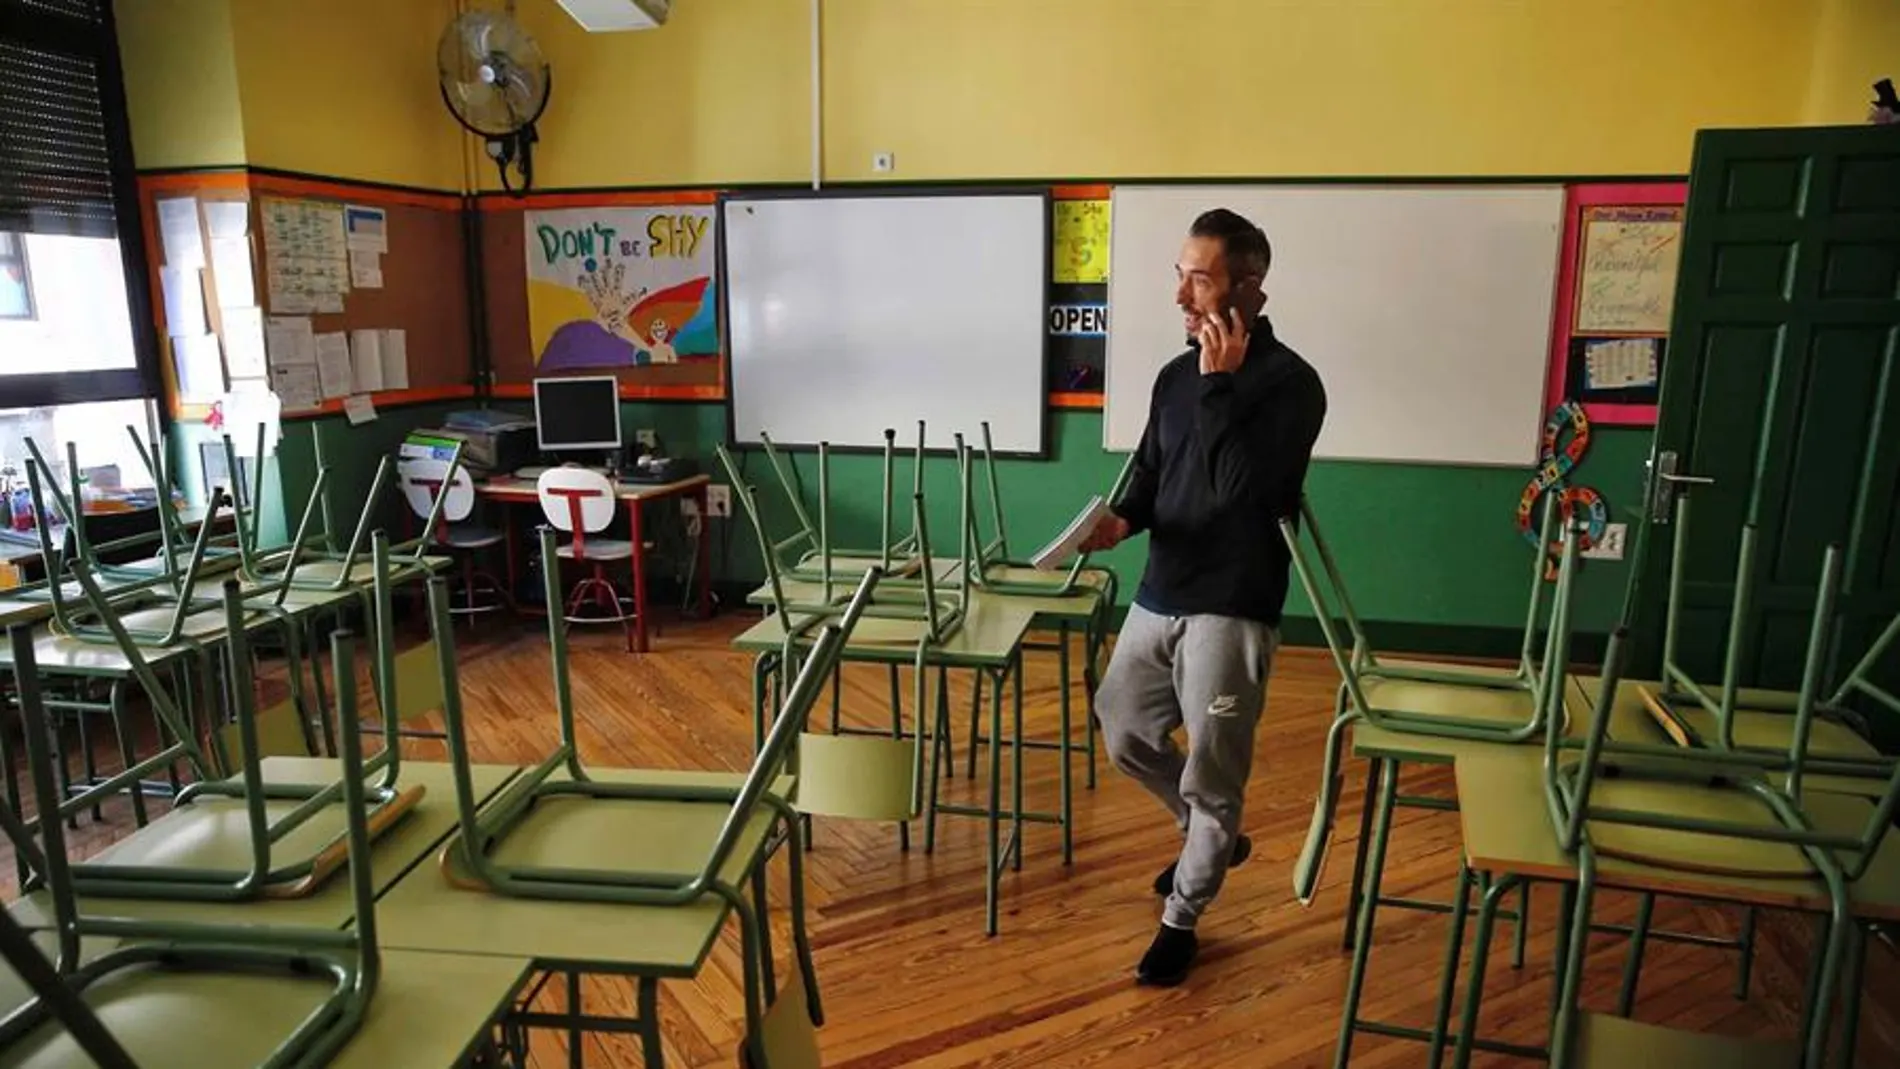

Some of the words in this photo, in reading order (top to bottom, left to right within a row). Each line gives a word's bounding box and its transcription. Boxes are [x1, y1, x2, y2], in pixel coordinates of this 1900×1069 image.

[537, 223, 616, 263] DON'T
[619, 240, 641, 258] BE
[647, 215, 708, 258] SHY
[1050, 308, 1107, 332] OPEN
